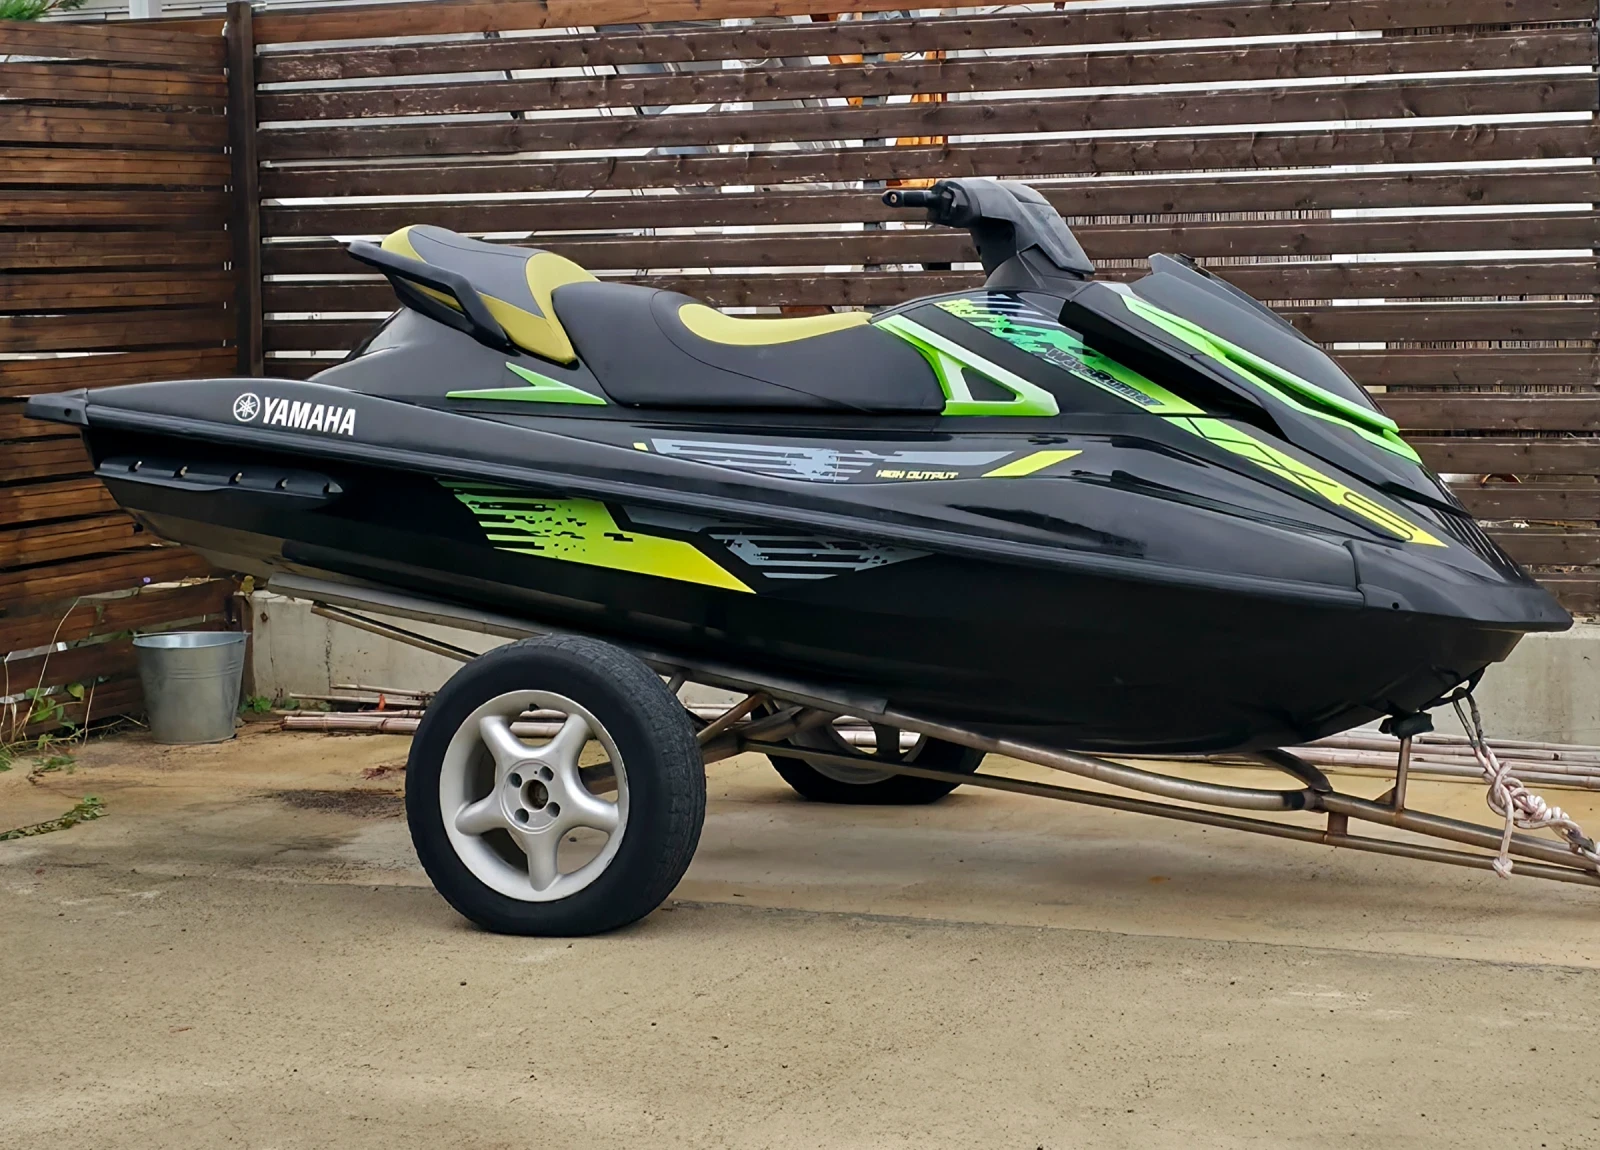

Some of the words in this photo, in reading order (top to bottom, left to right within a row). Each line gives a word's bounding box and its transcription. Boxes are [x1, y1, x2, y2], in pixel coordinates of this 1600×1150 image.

[262, 396, 356, 436] YAMAHA
[876, 469, 906, 479] HIGH
[906, 470, 959, 480] OUTPUT
